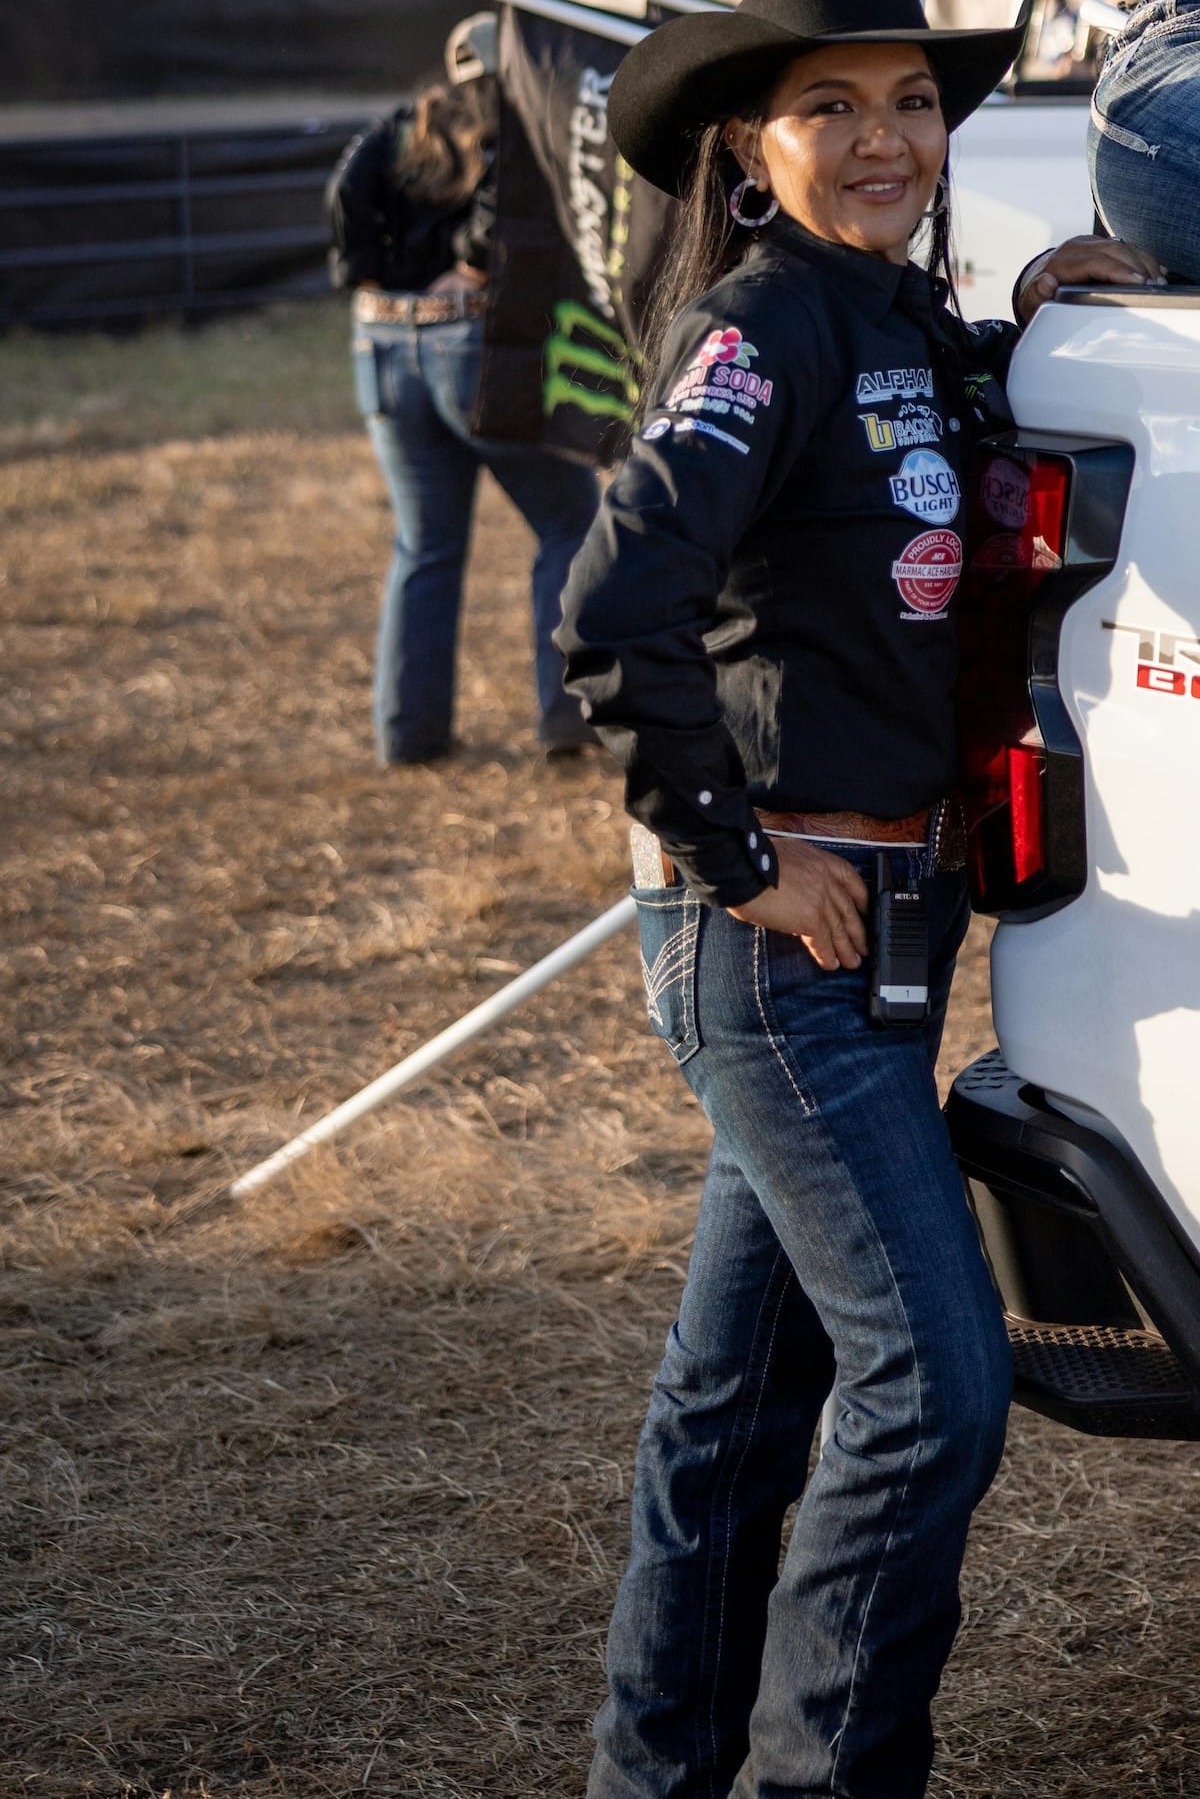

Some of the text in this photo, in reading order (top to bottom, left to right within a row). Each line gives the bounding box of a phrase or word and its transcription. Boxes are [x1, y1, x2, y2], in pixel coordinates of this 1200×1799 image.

[712, 366, 773, 407] SODA
[857, 368, 930, 394] ALPHA
[891, 471, 959, 502] BUSCH
[914, 497, 953, 512] LIGHT
[907, 534, 946, 560] PROUDLY
[931, 552, 946, 561] ACE
[895, 564, 926, 577] MARMAC
[927, 565, 939, 577] ACE
